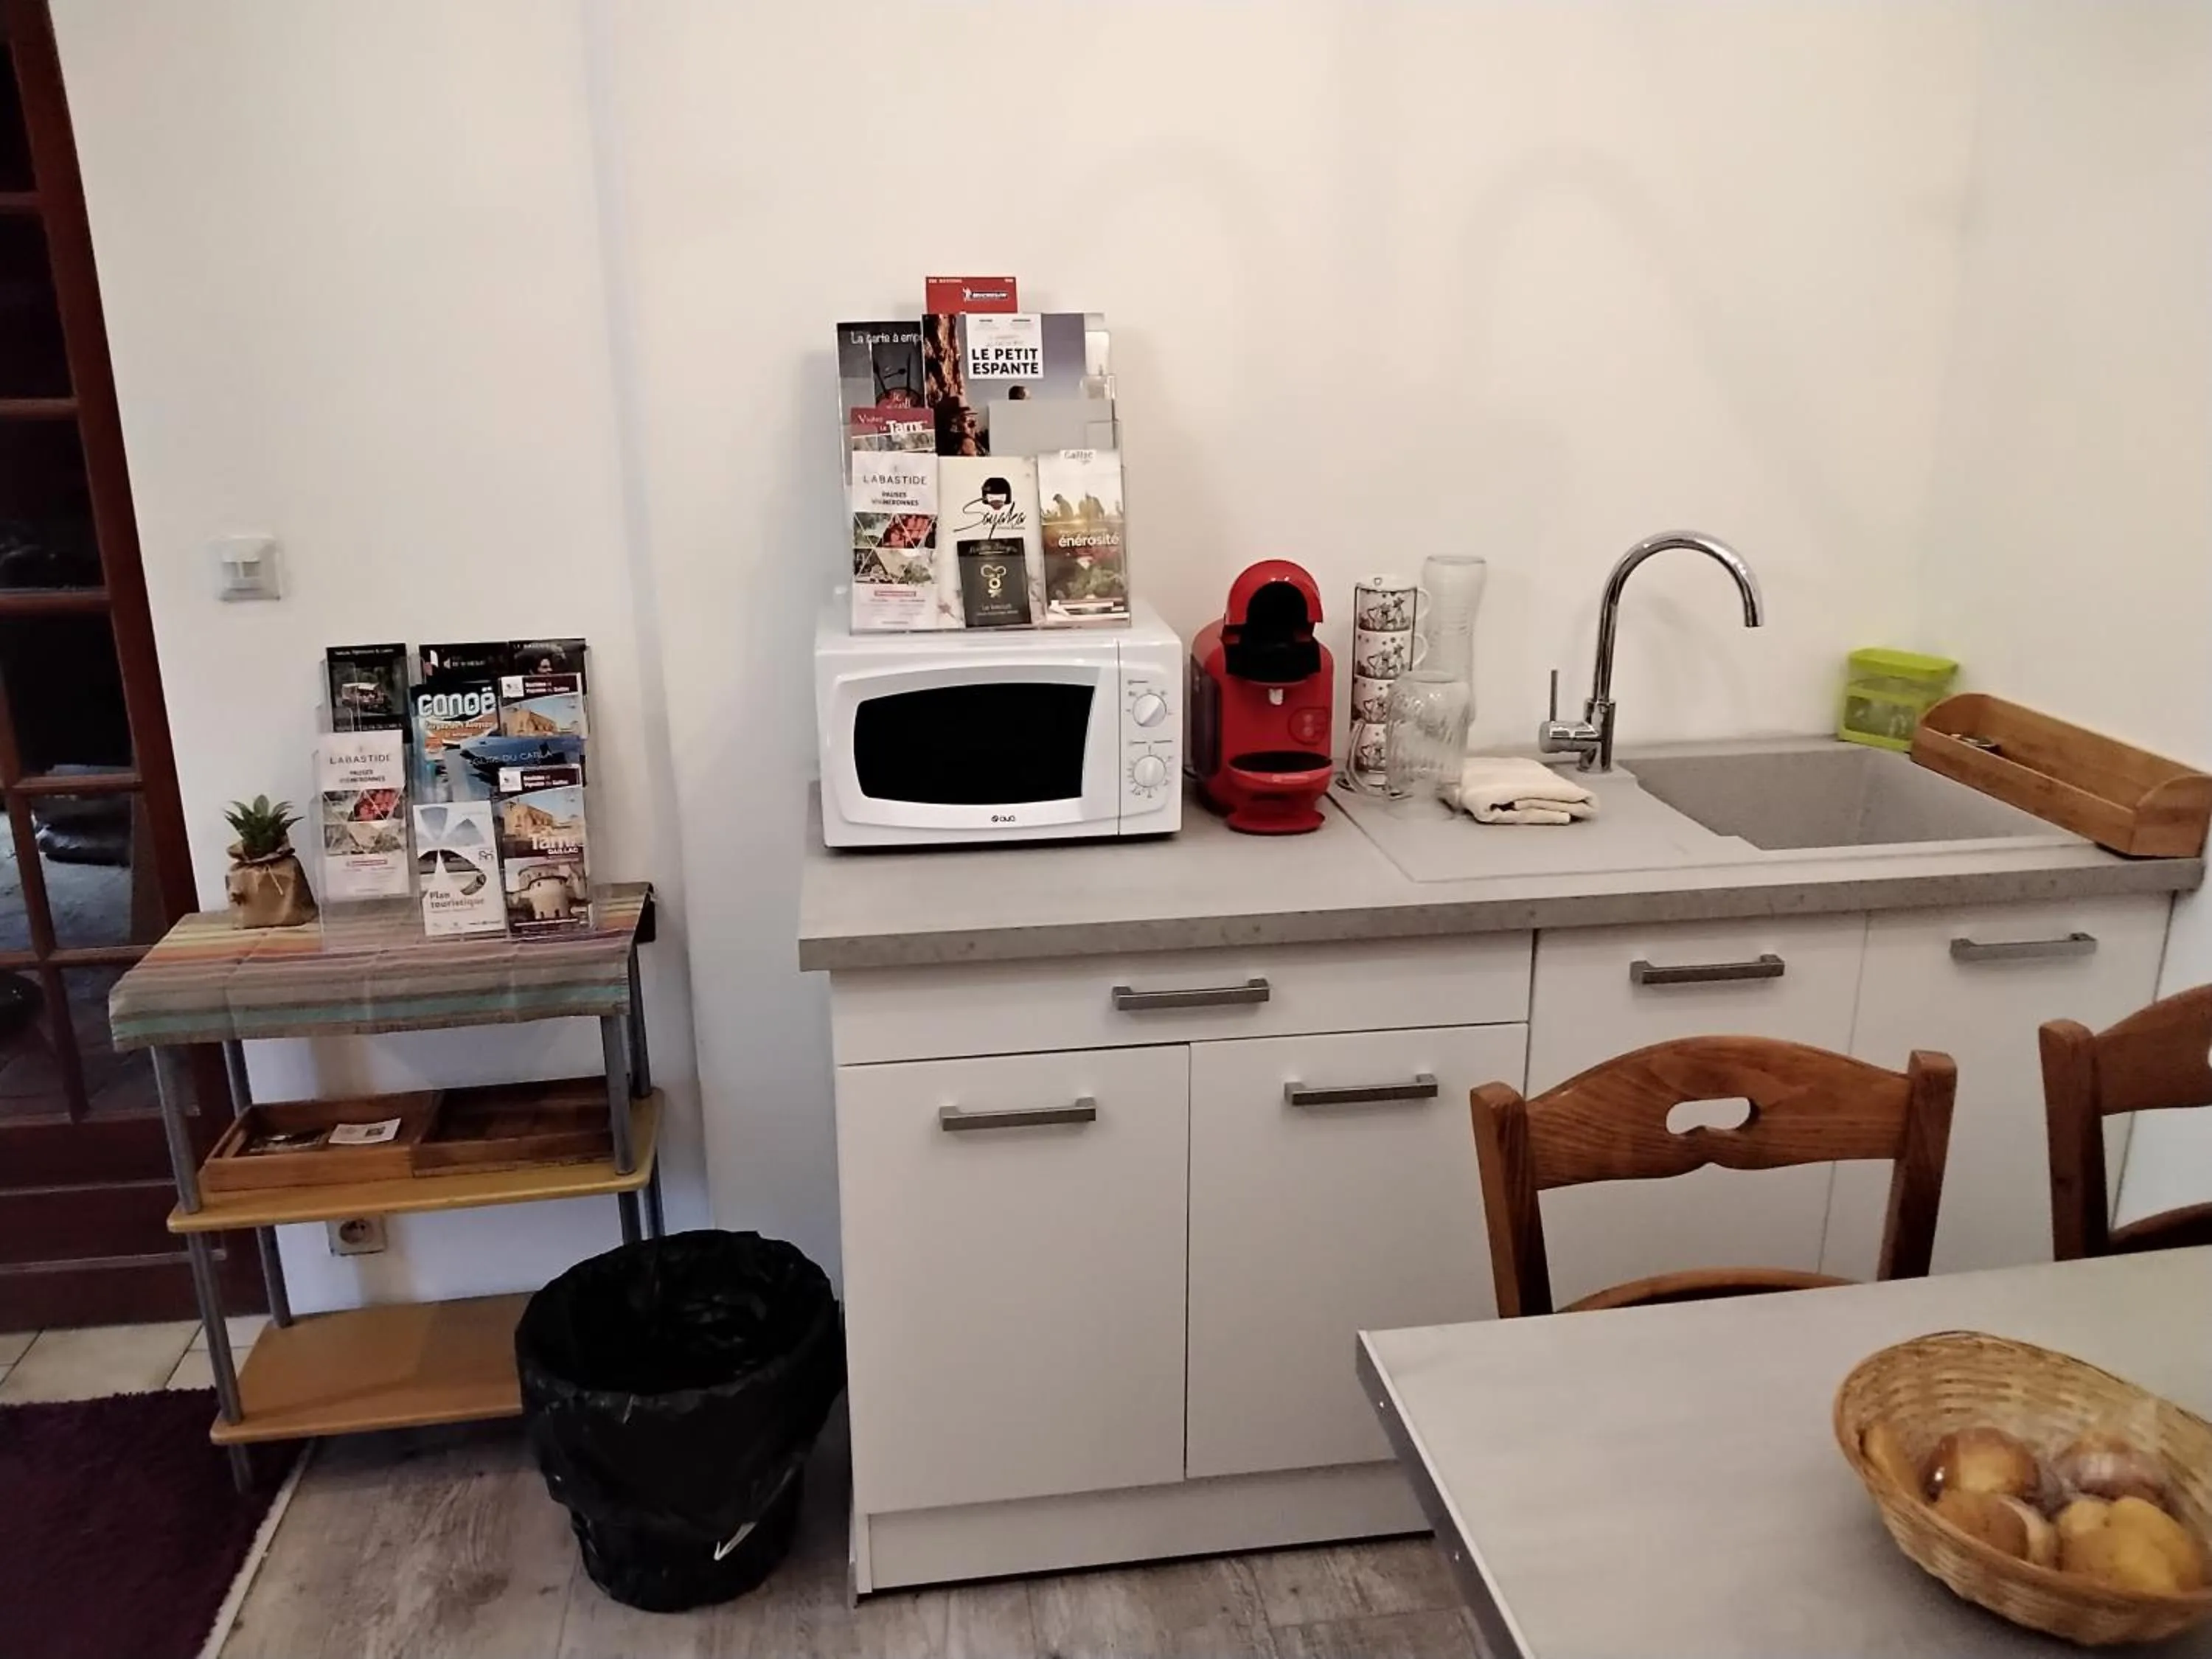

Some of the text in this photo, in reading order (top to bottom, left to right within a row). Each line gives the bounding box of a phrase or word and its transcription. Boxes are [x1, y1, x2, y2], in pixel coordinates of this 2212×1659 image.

[850, 331, 864, 344] La
[893, 333, 899, 343] à
[971, 348, 1038, 361] LE PETIT
[972, 362, 1039, 375] ESPANTE
[863, 475, 928, 484] LABASTIDE
[417, 686, 496, 717] canoë
[429, 891, 451, 900] Plan
